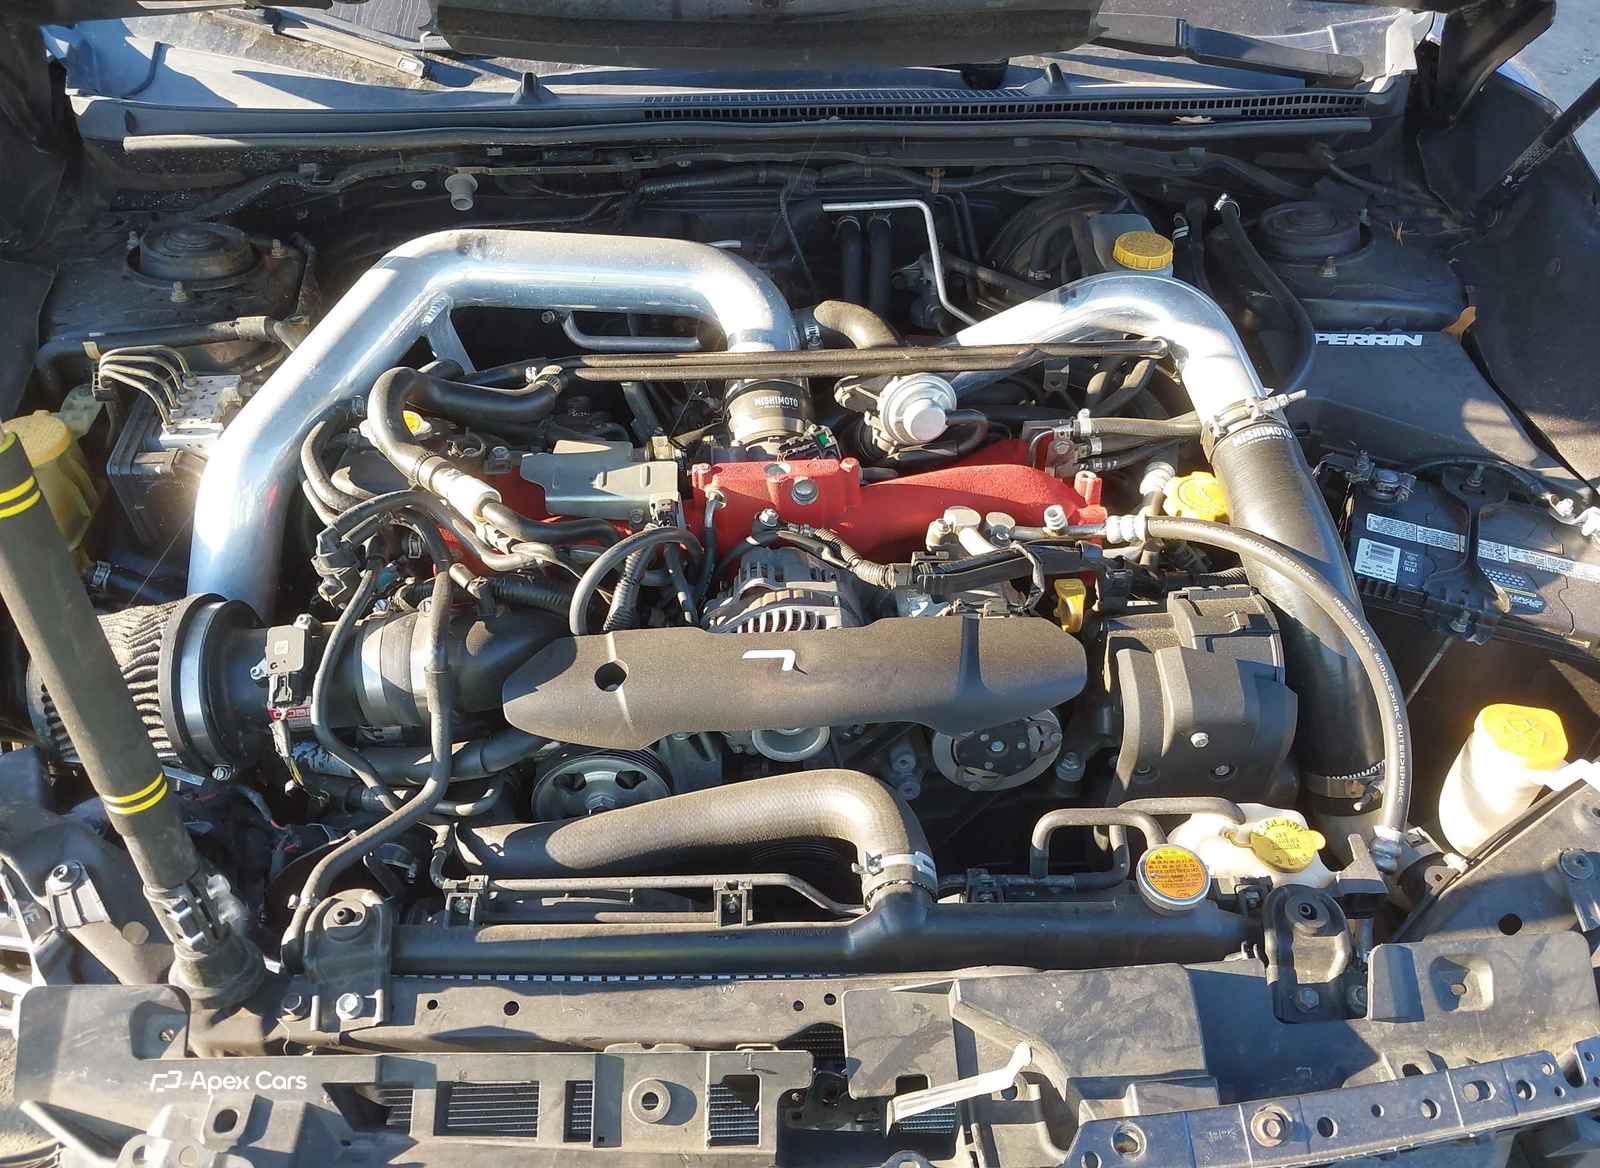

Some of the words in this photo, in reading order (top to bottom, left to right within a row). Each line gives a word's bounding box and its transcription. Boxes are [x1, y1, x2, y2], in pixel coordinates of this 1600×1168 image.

[1315, 333, 1423, 346] PERRIN
[753, 396, 799, 407] MISHIMOTO
[1231, 426, 1293, 447] MISHIMOTO
